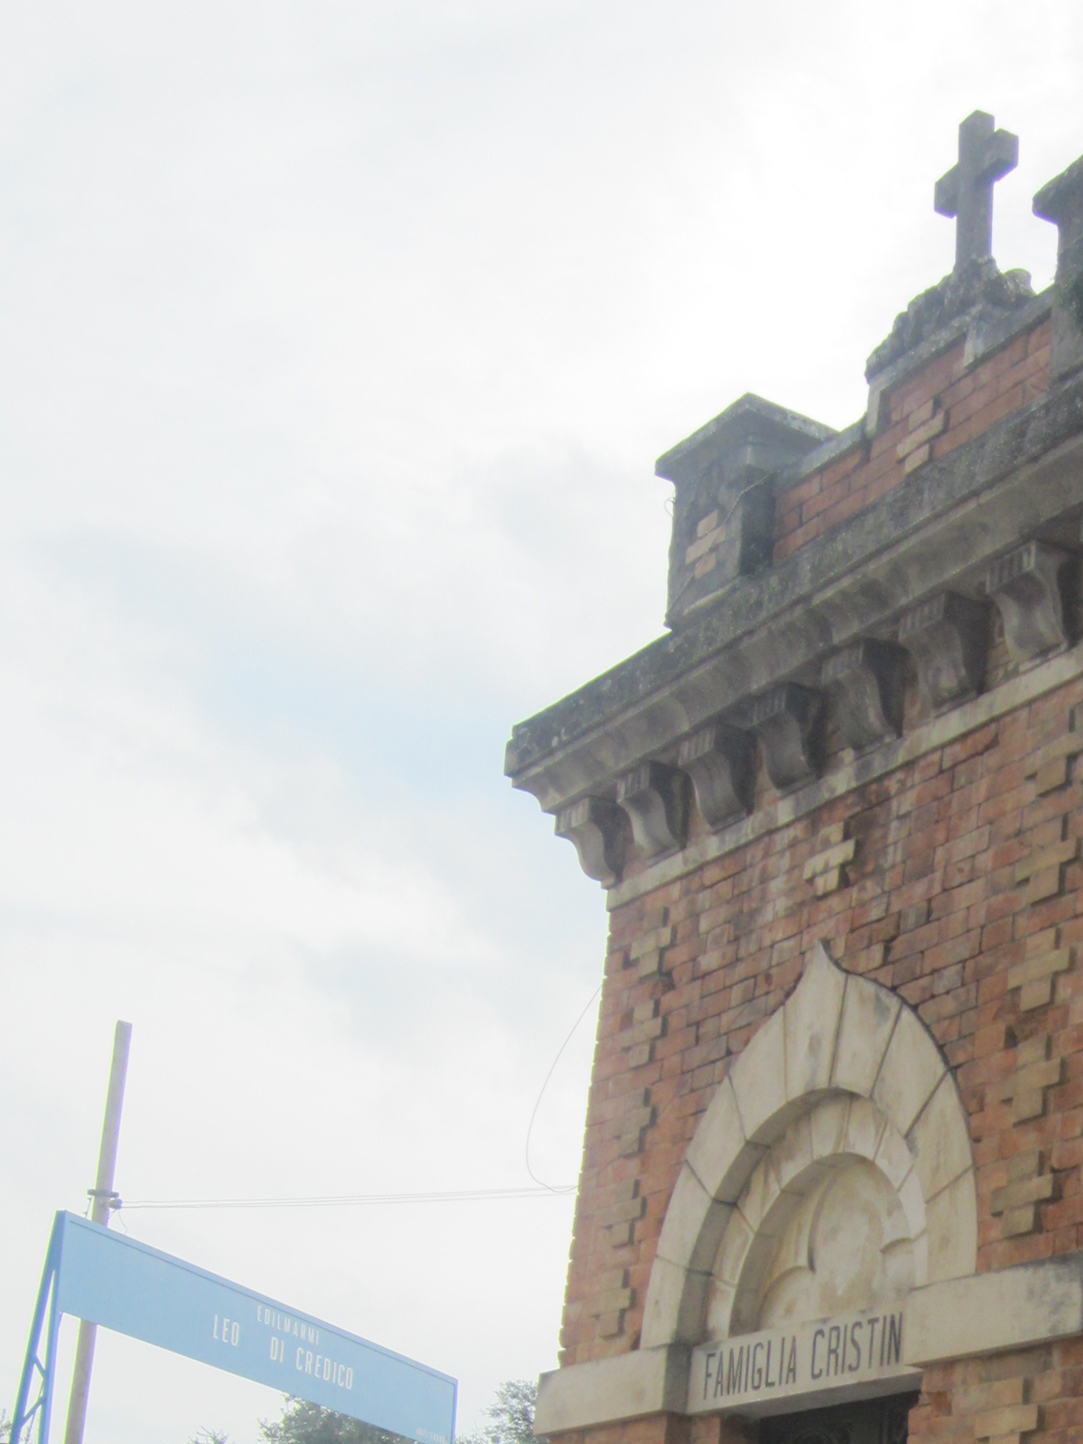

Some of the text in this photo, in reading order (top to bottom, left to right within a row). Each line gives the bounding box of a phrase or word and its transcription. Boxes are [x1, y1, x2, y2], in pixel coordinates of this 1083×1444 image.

[212, 1314, 354, 1390] LEO DI CREDICO
[256, 1305, 320, 1346] EDILMARMI
[703, 1311, 904, 1400] FAMIGLIA CRISTIN
